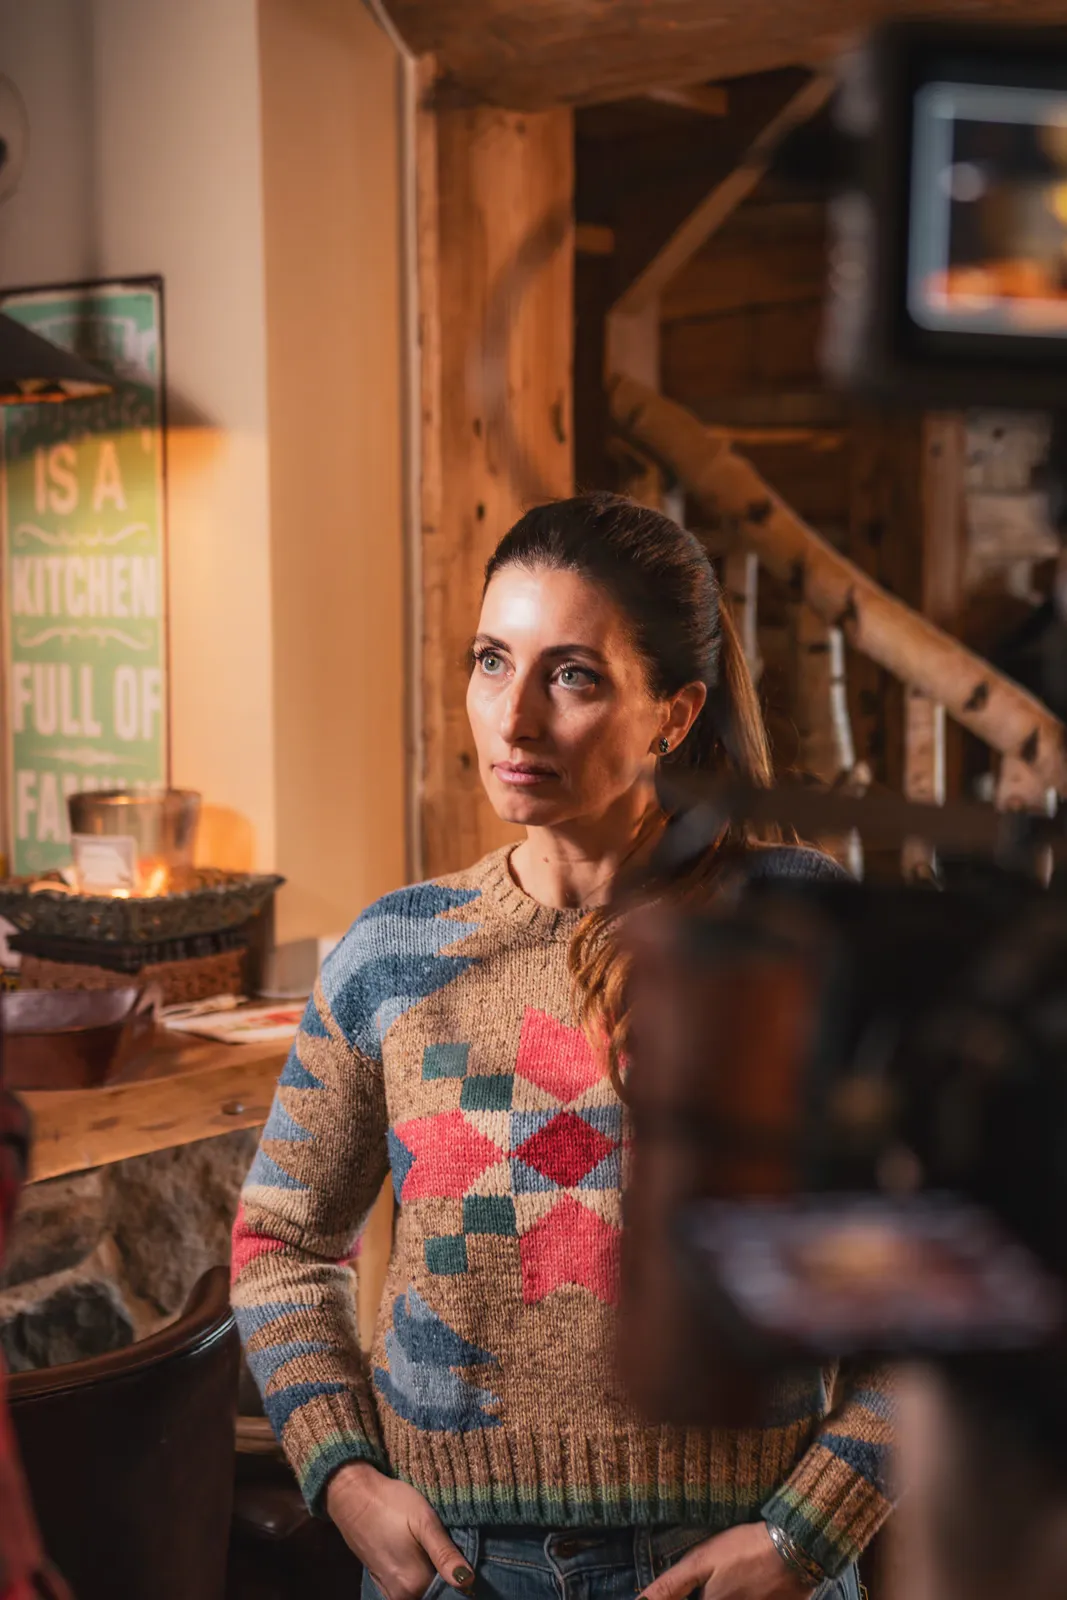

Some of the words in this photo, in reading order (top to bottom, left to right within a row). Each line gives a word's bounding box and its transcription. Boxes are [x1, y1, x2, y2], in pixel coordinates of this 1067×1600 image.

[34, 443, 79, 516] IS
[92, 439, 128, 514] A
[11, 554, 157, 619] KITCHEN
[12, 661, 103, 738] FULL
[113, 664, 162, 741] OF
